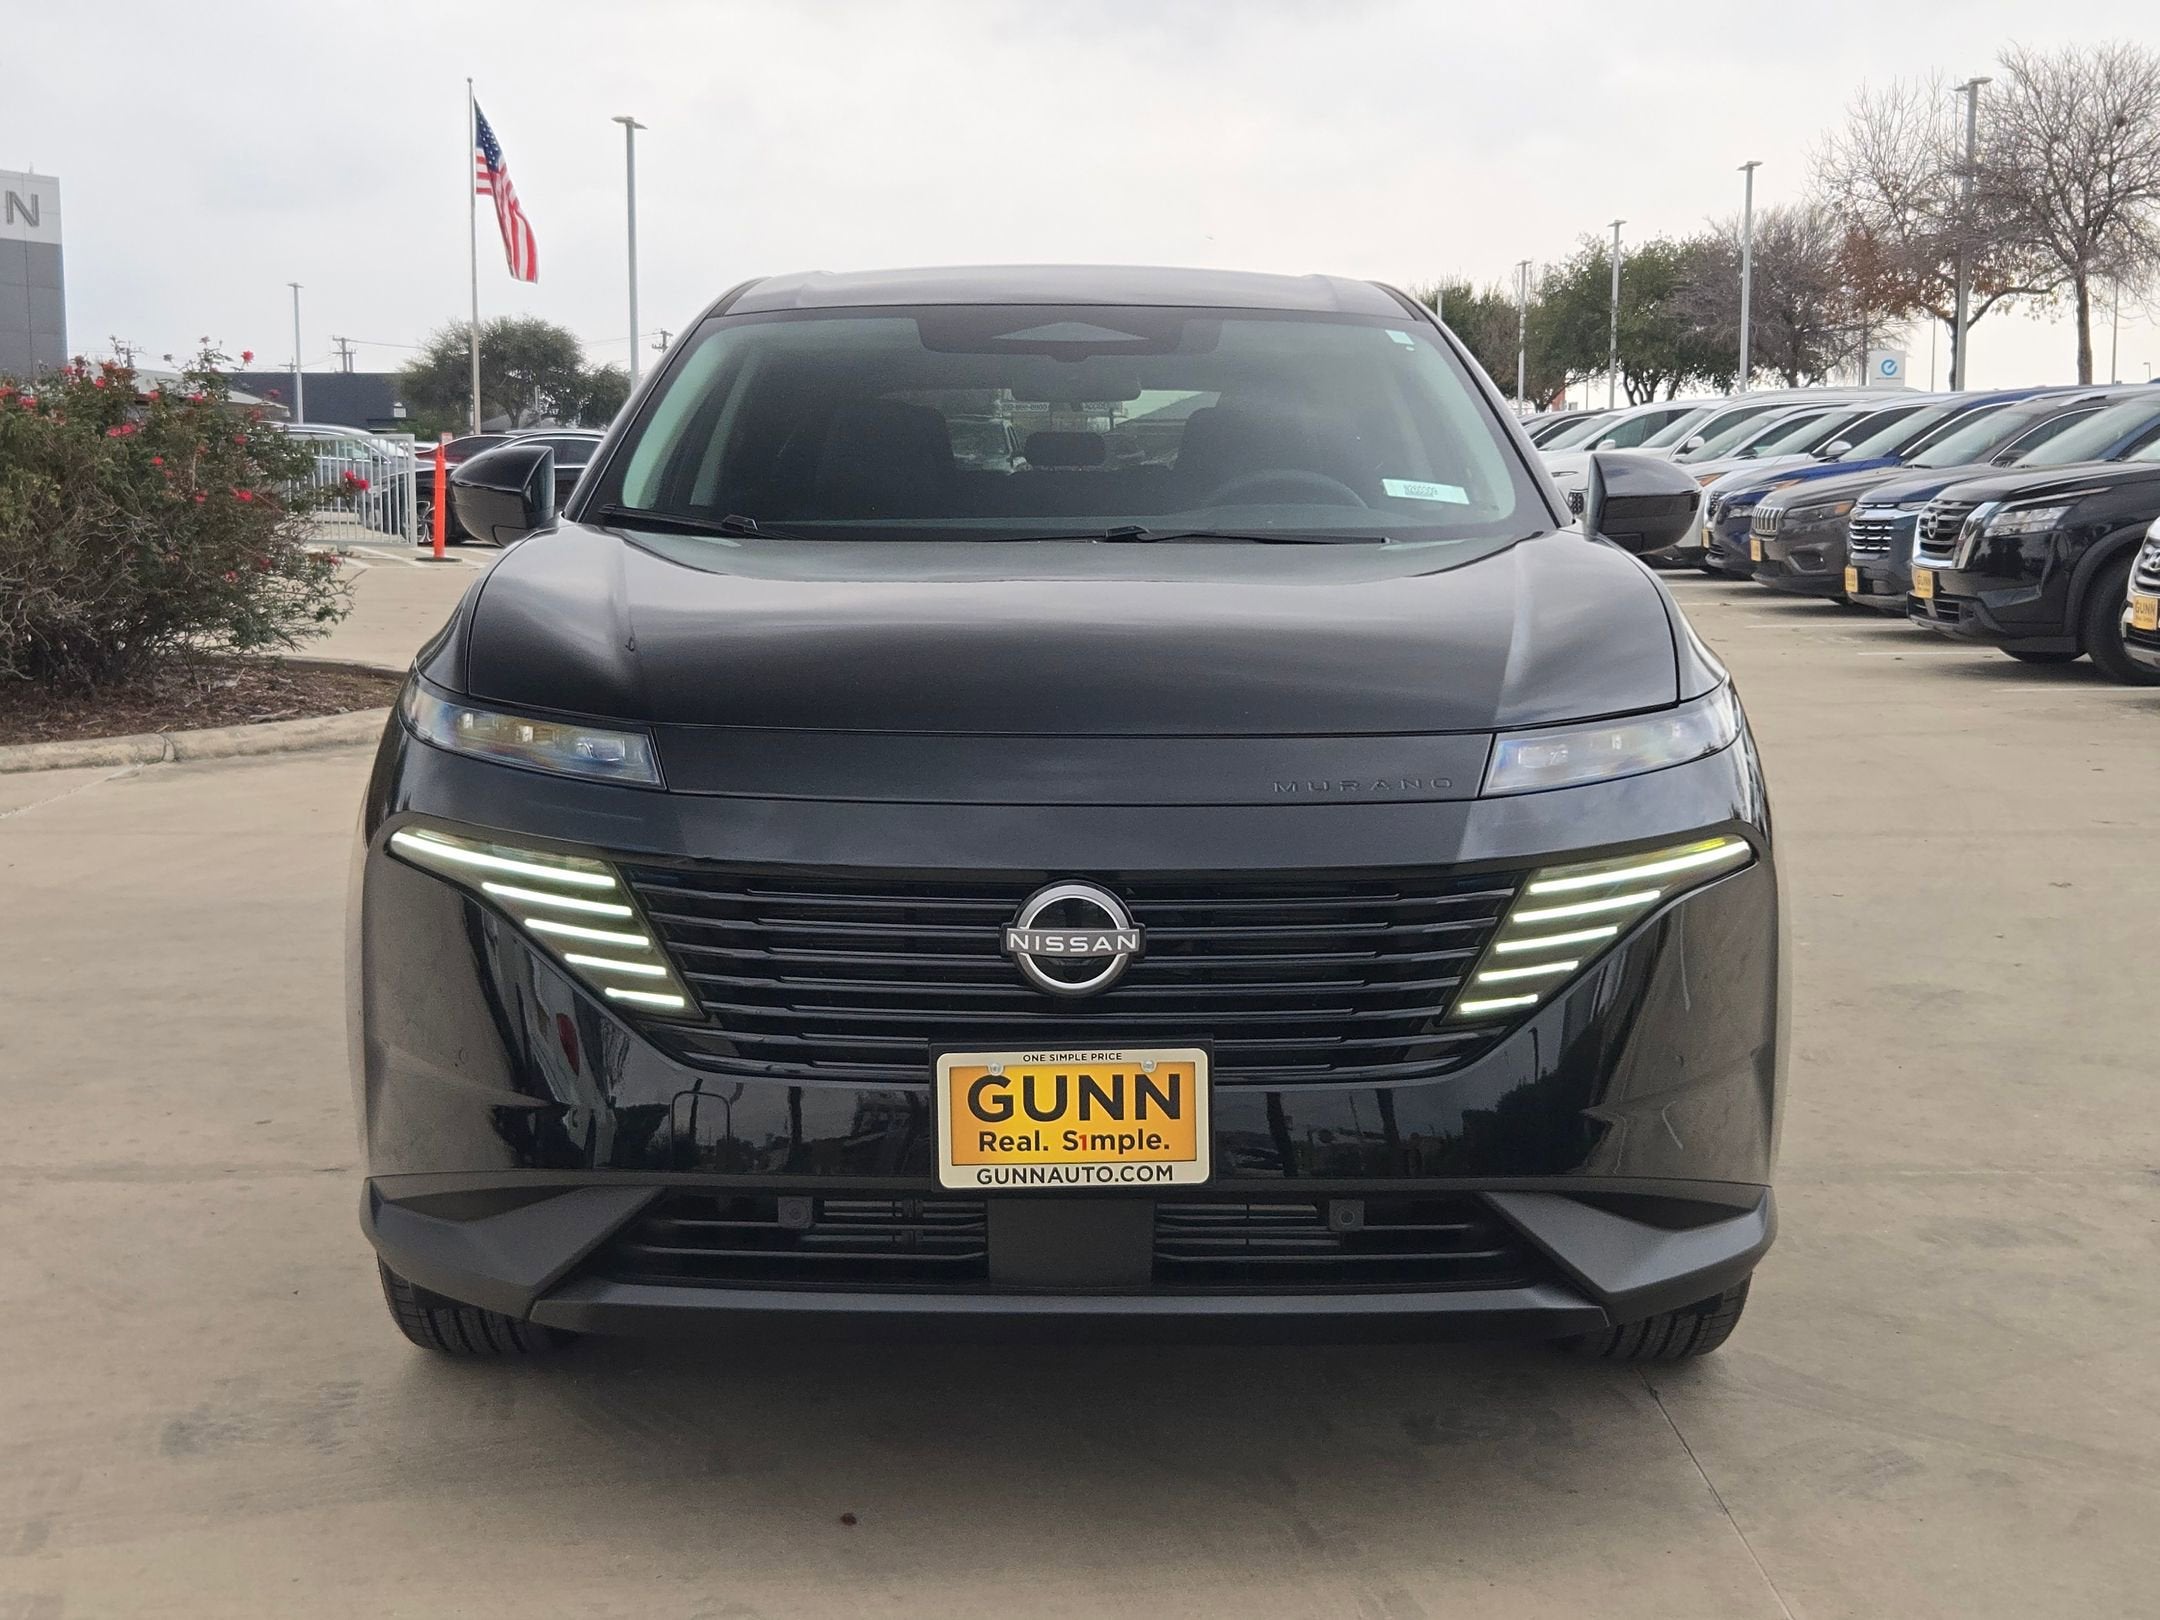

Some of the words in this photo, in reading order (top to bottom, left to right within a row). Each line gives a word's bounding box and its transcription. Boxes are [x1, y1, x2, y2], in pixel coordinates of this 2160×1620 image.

[1273, 778, 1453, 793] MURANO
[1010, 933, 1136, 952] NISSAN
[1023, 1054, 1046, 1062] ONE
[1049, 1053, 1087, 1062] SIMPLE
[1091, 1052, 1123, 1061] PRICE
[967, 1073, 1181, 1122] GUNN
[979, 1130, 1049, 1152] Real.
[976, 1165, 1173, 1185] GUNNAUTO.COM
